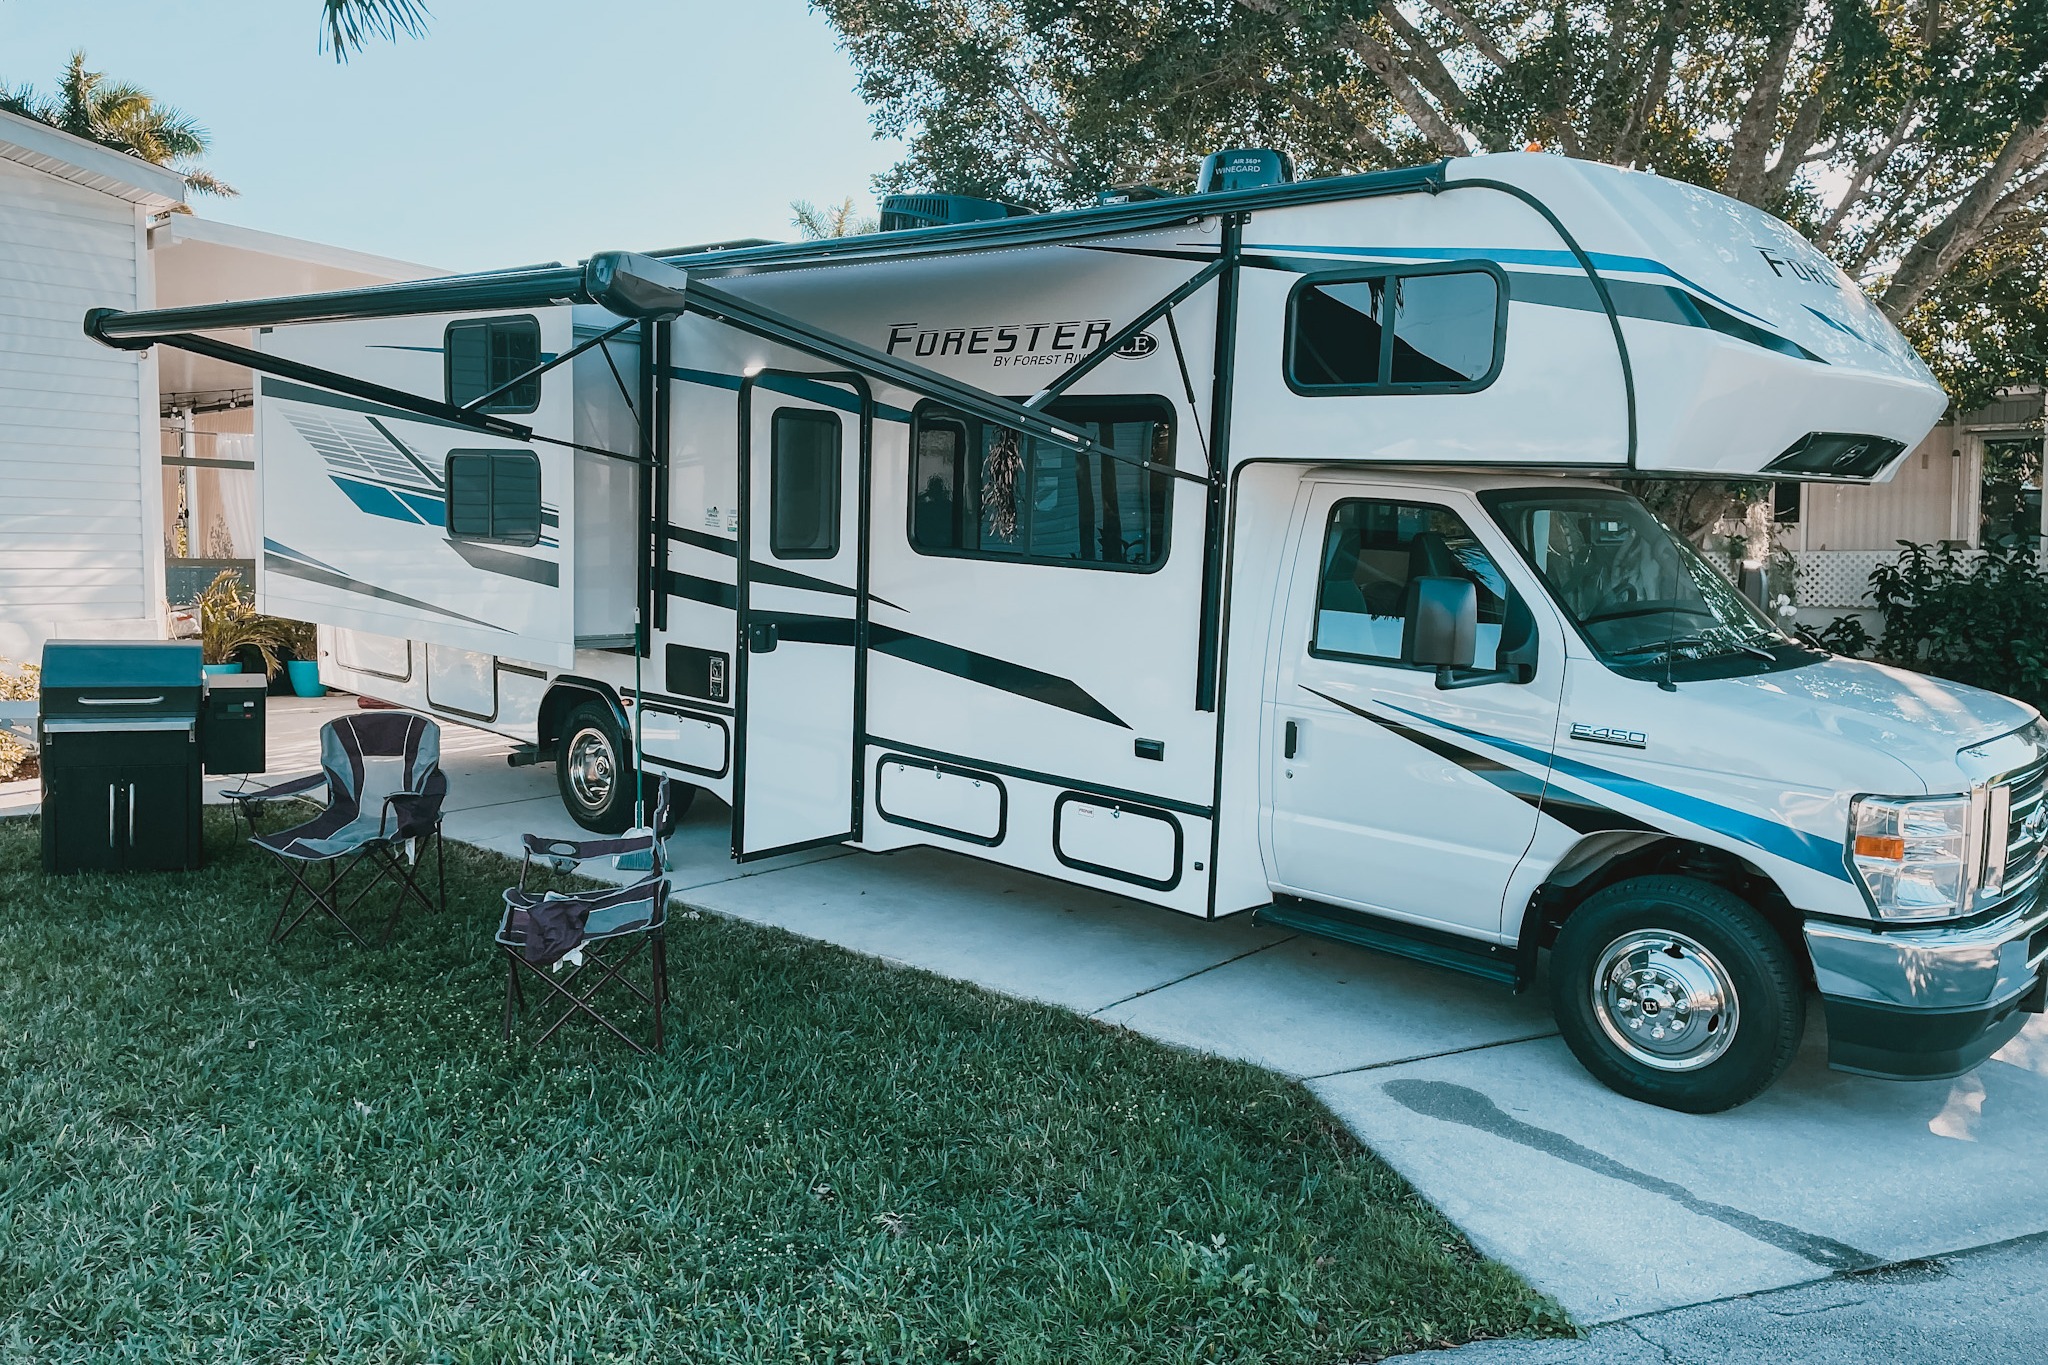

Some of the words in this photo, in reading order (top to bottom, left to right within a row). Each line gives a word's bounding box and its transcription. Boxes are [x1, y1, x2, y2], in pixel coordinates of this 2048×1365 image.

[1216, 165, 1261, 175] WINEGARD
[886, 319, 1111, 357] FORESTER
[993, 355, 1011, 367] BY
[1013, 354, 1058, 366] FOREST
[1066, 352, 1089, 365] RIV
